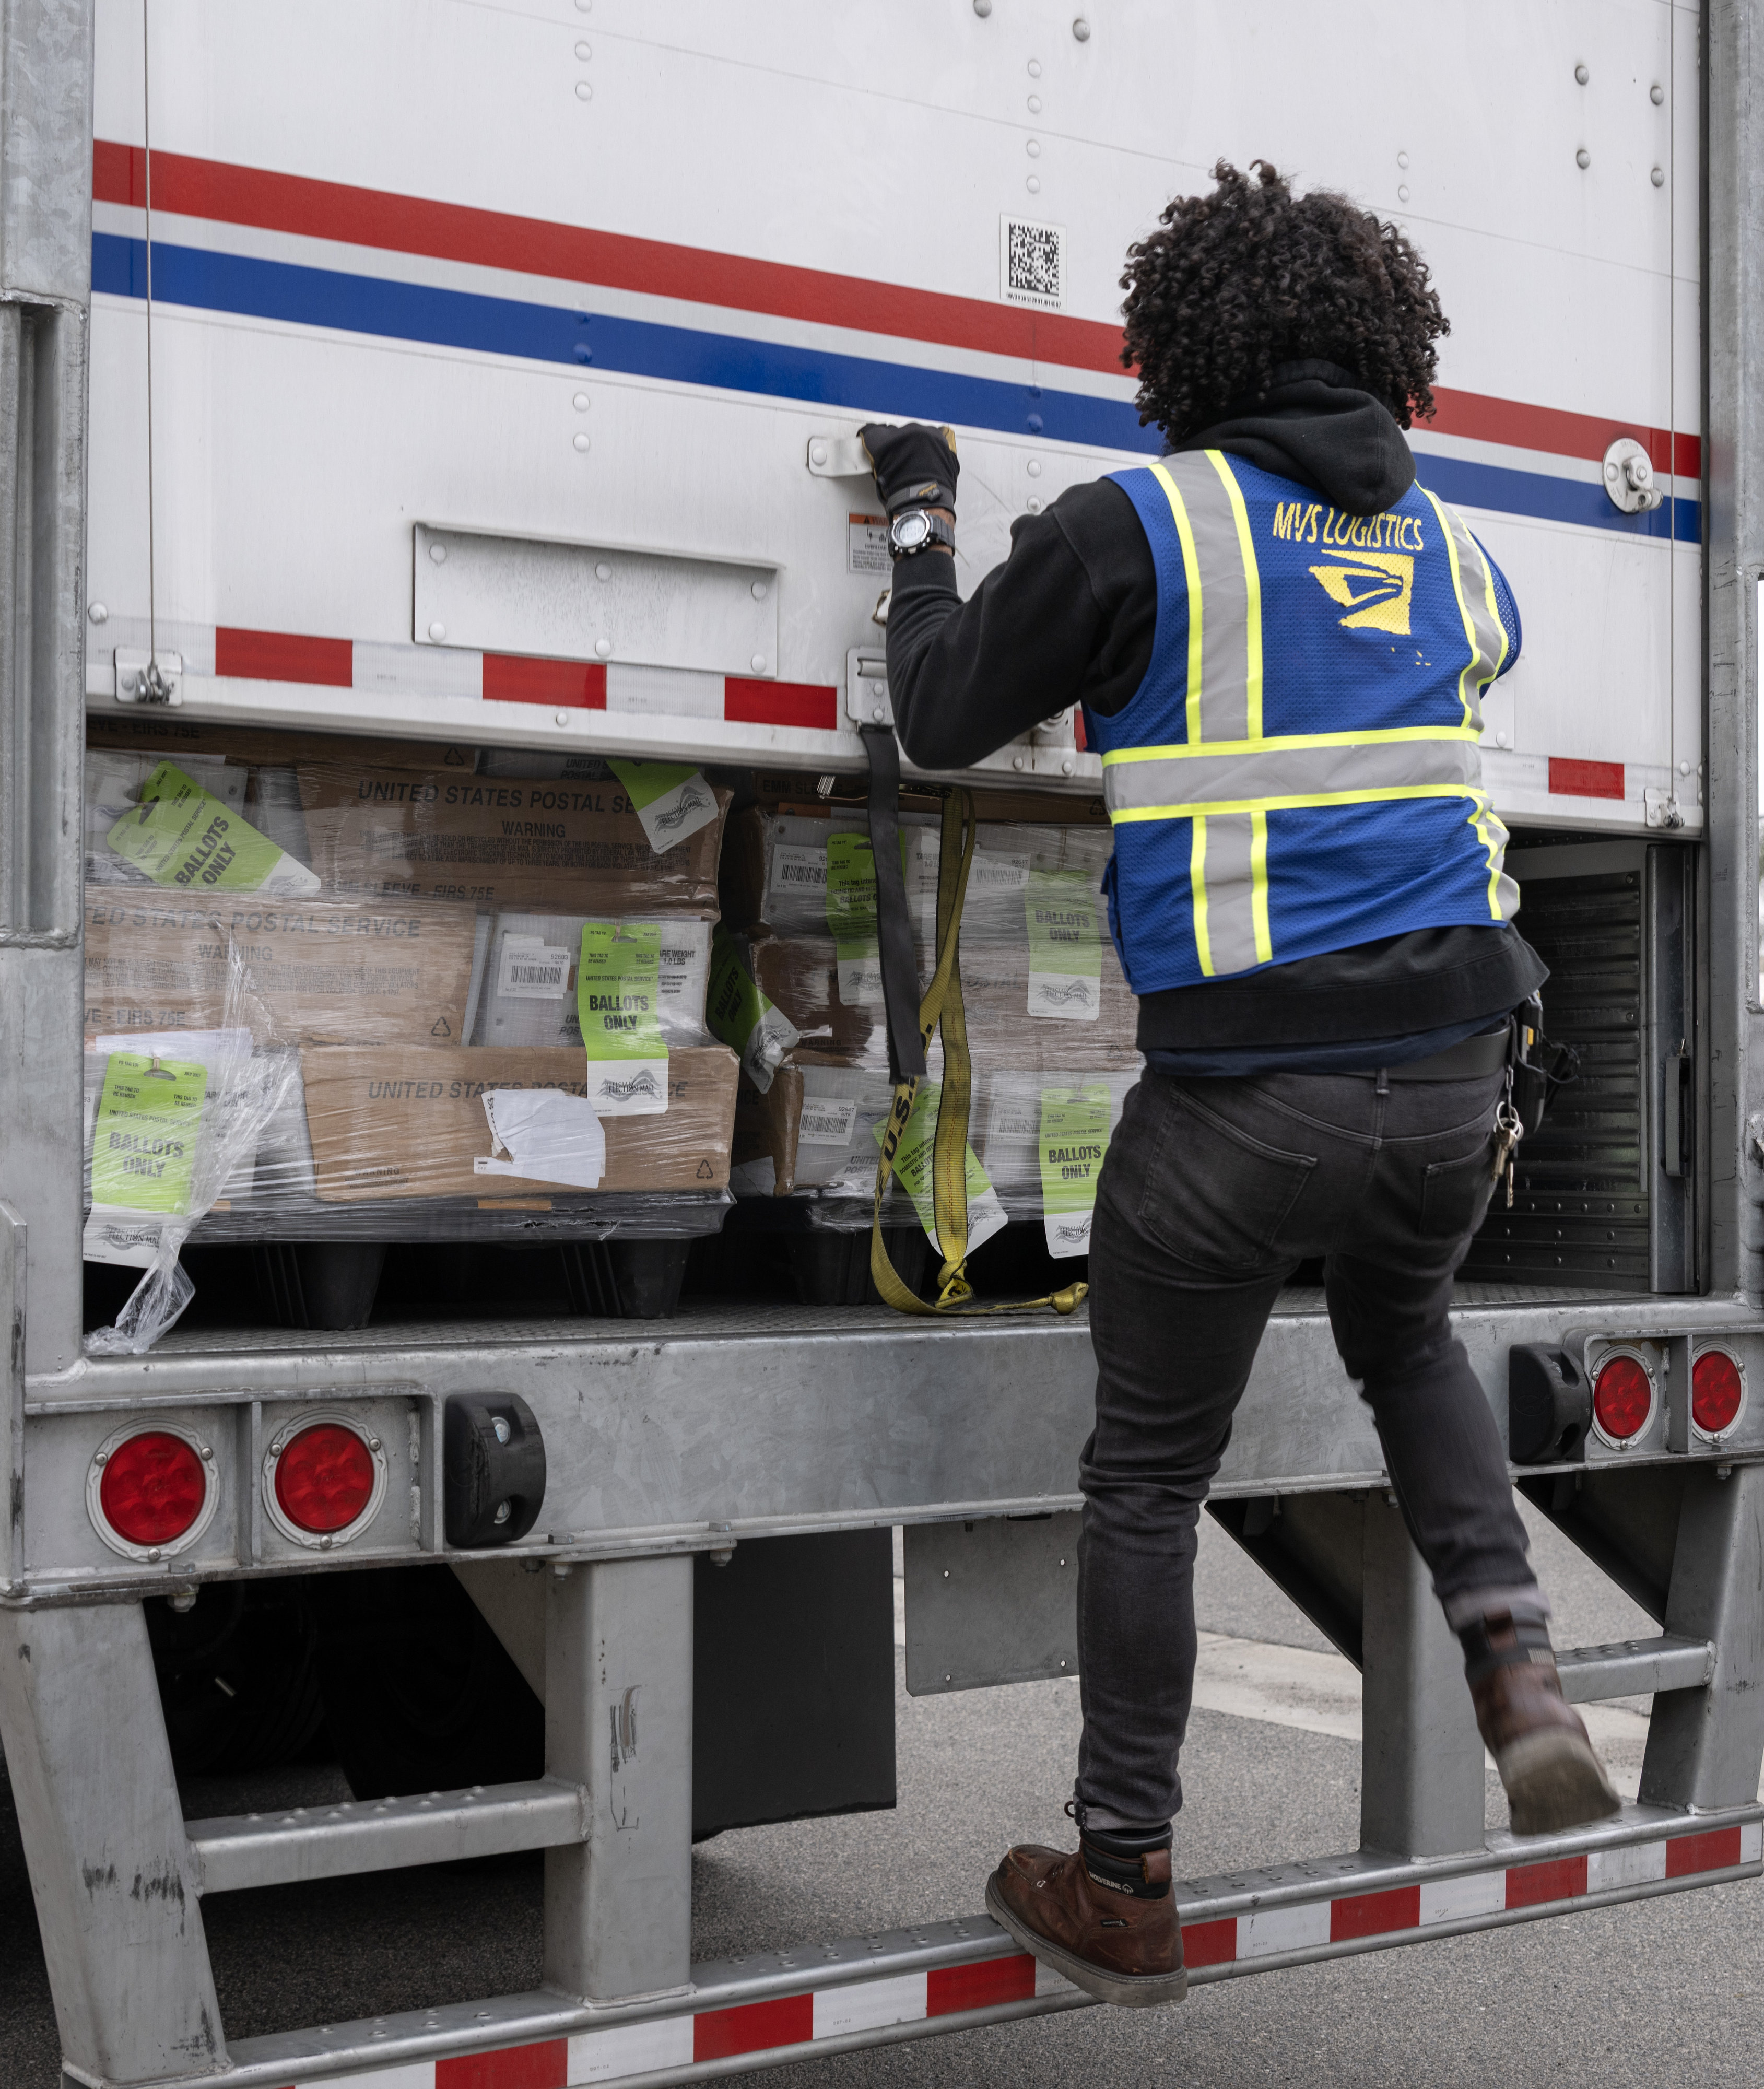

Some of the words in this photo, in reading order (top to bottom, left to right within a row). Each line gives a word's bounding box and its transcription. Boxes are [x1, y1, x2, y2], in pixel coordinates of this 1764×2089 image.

[1273, 502, 1322, 543] MVS
[1323, 507, 1424, 550] LOGISTICS
[566, 758, 600, 769] UNITED
[763, 780, 791, 793] EMM
[358, 781, 439, 803] UNITED
[445, 785, 522, 808] STATES
[530, 790, 605, 813] POSTAL
[662, 805, 687, 825] ELECTION
[686, 797, 702, 810] MAIL
[502, 820, 566, 838] WARNING
[156, 854, 170, 872] UNITED
[169, 836, 183, 856] STATES
[181, 820, 194, 839] POSTAL
[174, 816, 230, 887] BALLOTS
[202, 840, 237, 885] ONLY
[433, 885, 466, 899] EIRS
[470, 886, 495, 900] 75E
[133, 910, 222, 929] STATES
[230, 912, 319, 933] POSTAL
[327, 915, 421, 937] SERVICE
[1036, 910, 1090, 928] BALLOTS
[1049, 927, 1080, 942] ONLY
[715, 966, 739, 1021] BALLOTS
[1045, 989, 1073, 999] ELECTION
[590, 995, 649, 1011] BALLOTS
[728, 988, 743, 1023] ONLY
[117, 1010, 153, 1025] EIRS
[159, 1011, 186, 1026] 75E
[604, 1015, 638, 1031] ONLY
[767, 1030, 780, 1045] MAIL
[369, 1082, 442, 1099] UNITED
[129, 1111, 148, 1120] STATES
[149, 1114, 168, 1123] POSTAL
[109, 1131, 184, 1158] BALLOTS
[901, 1154, 911, 1164] This
[911, 1147, 919, 1157] tag
[1049, 1144, 1101, 1164] BALLOTS
[123, 1156, 167, 1178] ONLY
[355, 1167, 399, 1176] WARNING
[899, 1159, 918, 1175] DOMESTIC
[918, 1151, 926, 1161] AND
[1062, 1163, 1091, 1180] ONLY
[974, 1210, 987, 1222] MAIL
[108, 1231, 144, 1241] ELECTION
[1062, 1227, 1088, 1237] ELECTION
[1089, 1870, 1122, 1890] WOLVERINE
